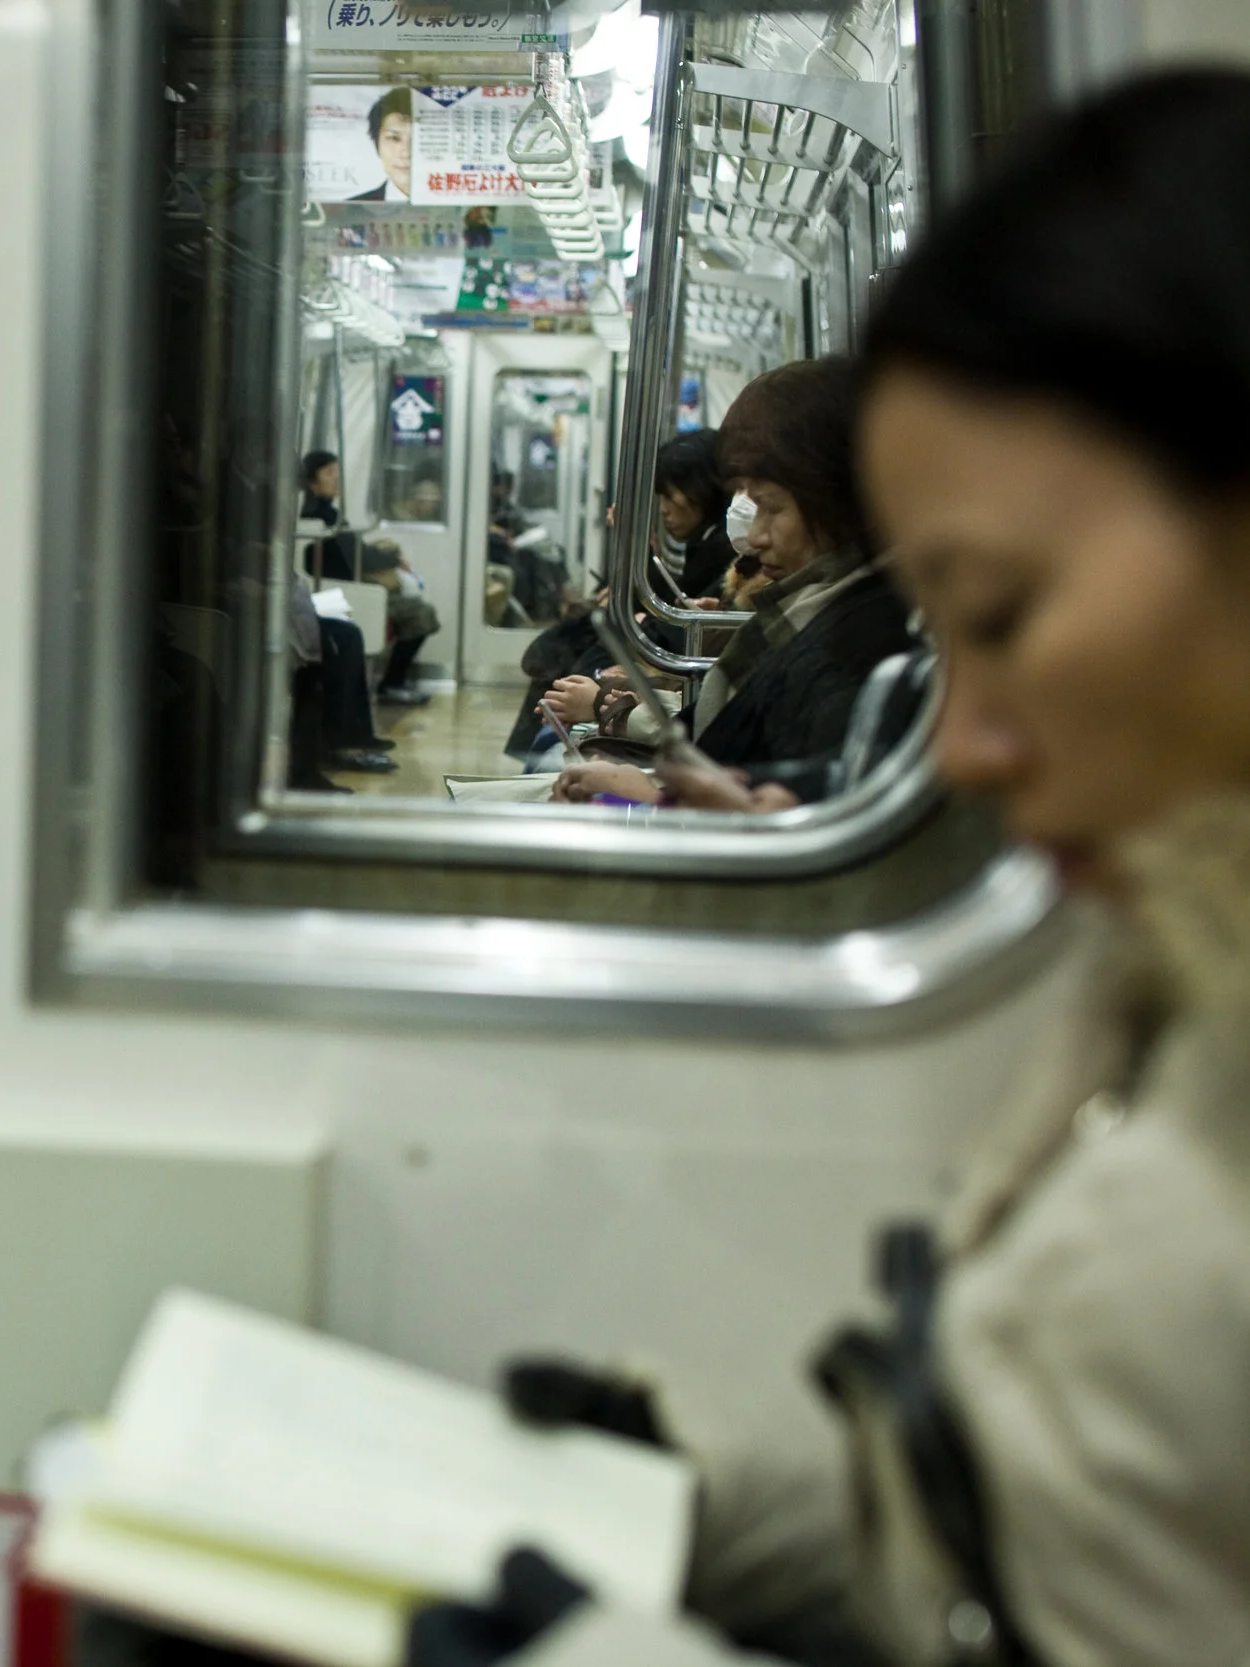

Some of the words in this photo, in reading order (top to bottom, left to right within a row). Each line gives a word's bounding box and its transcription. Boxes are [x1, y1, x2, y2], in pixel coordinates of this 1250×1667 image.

[427, 172, 537, 193] 佐野厄よけ大
